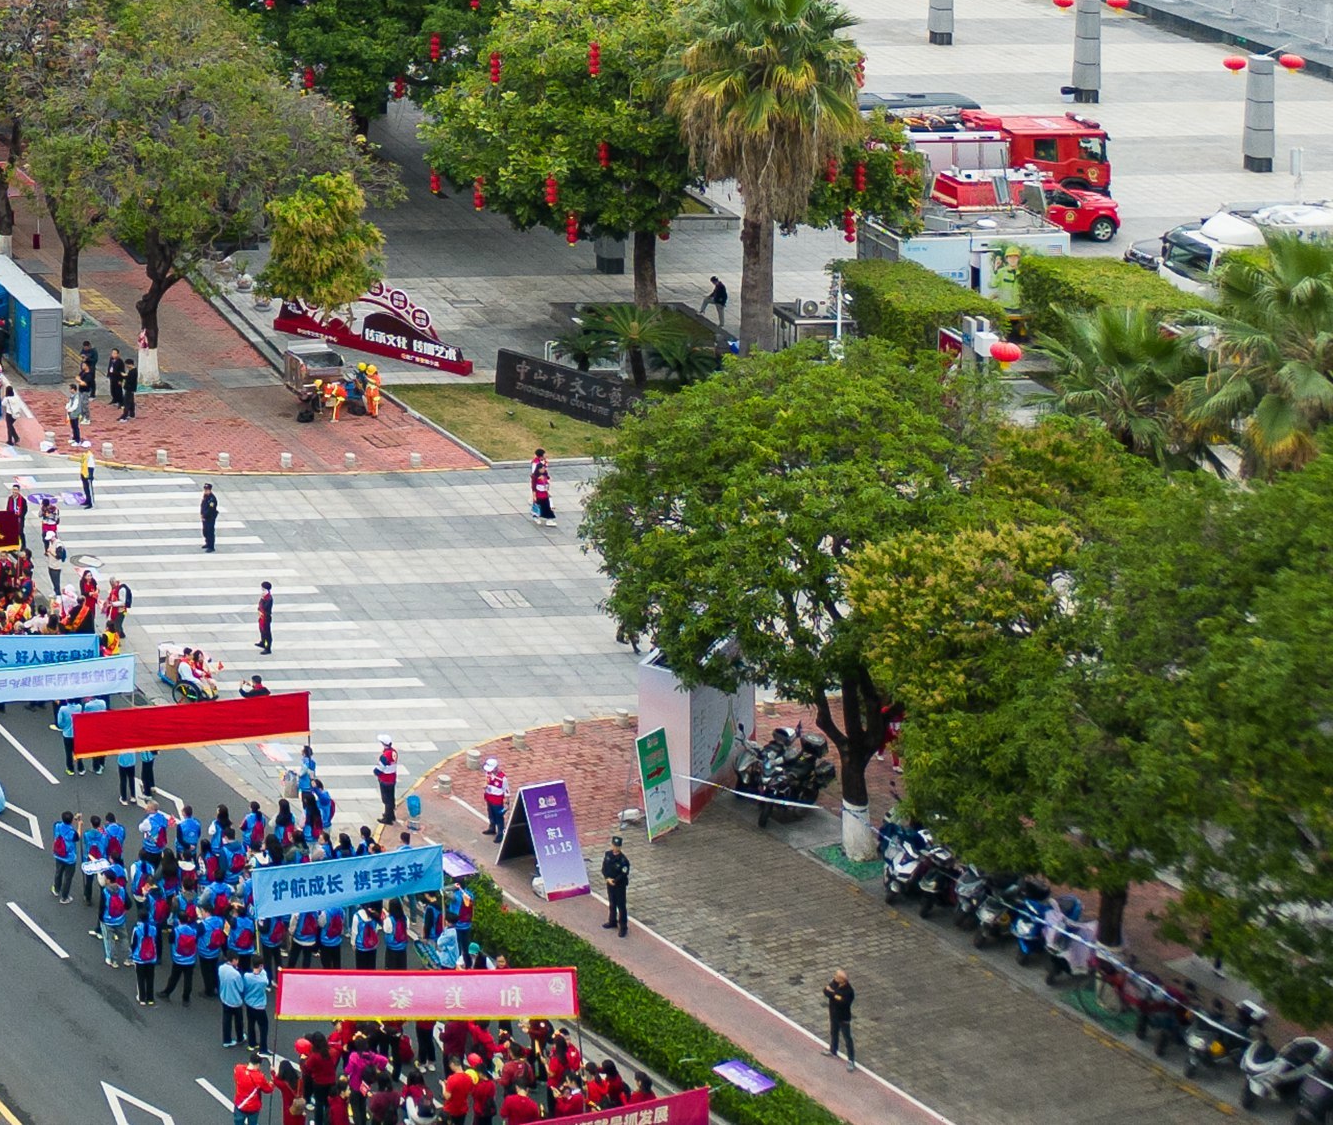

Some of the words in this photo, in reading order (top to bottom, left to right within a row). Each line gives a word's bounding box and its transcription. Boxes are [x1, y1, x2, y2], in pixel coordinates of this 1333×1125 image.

[364, 327, 408, 350] 传承文化
[412, 339, 458, 362] 传播艺术
[515, 382, 568, 404] ZHONGSHAN
[570, 396, 611, 416] CULTURE
[15, 648, 95, 664] 好人就在身边
[545, 827, 564, 841] 东1
[271, 872, 344, 902] 护航成长
[353, 862, 425, 893] 携手未来
